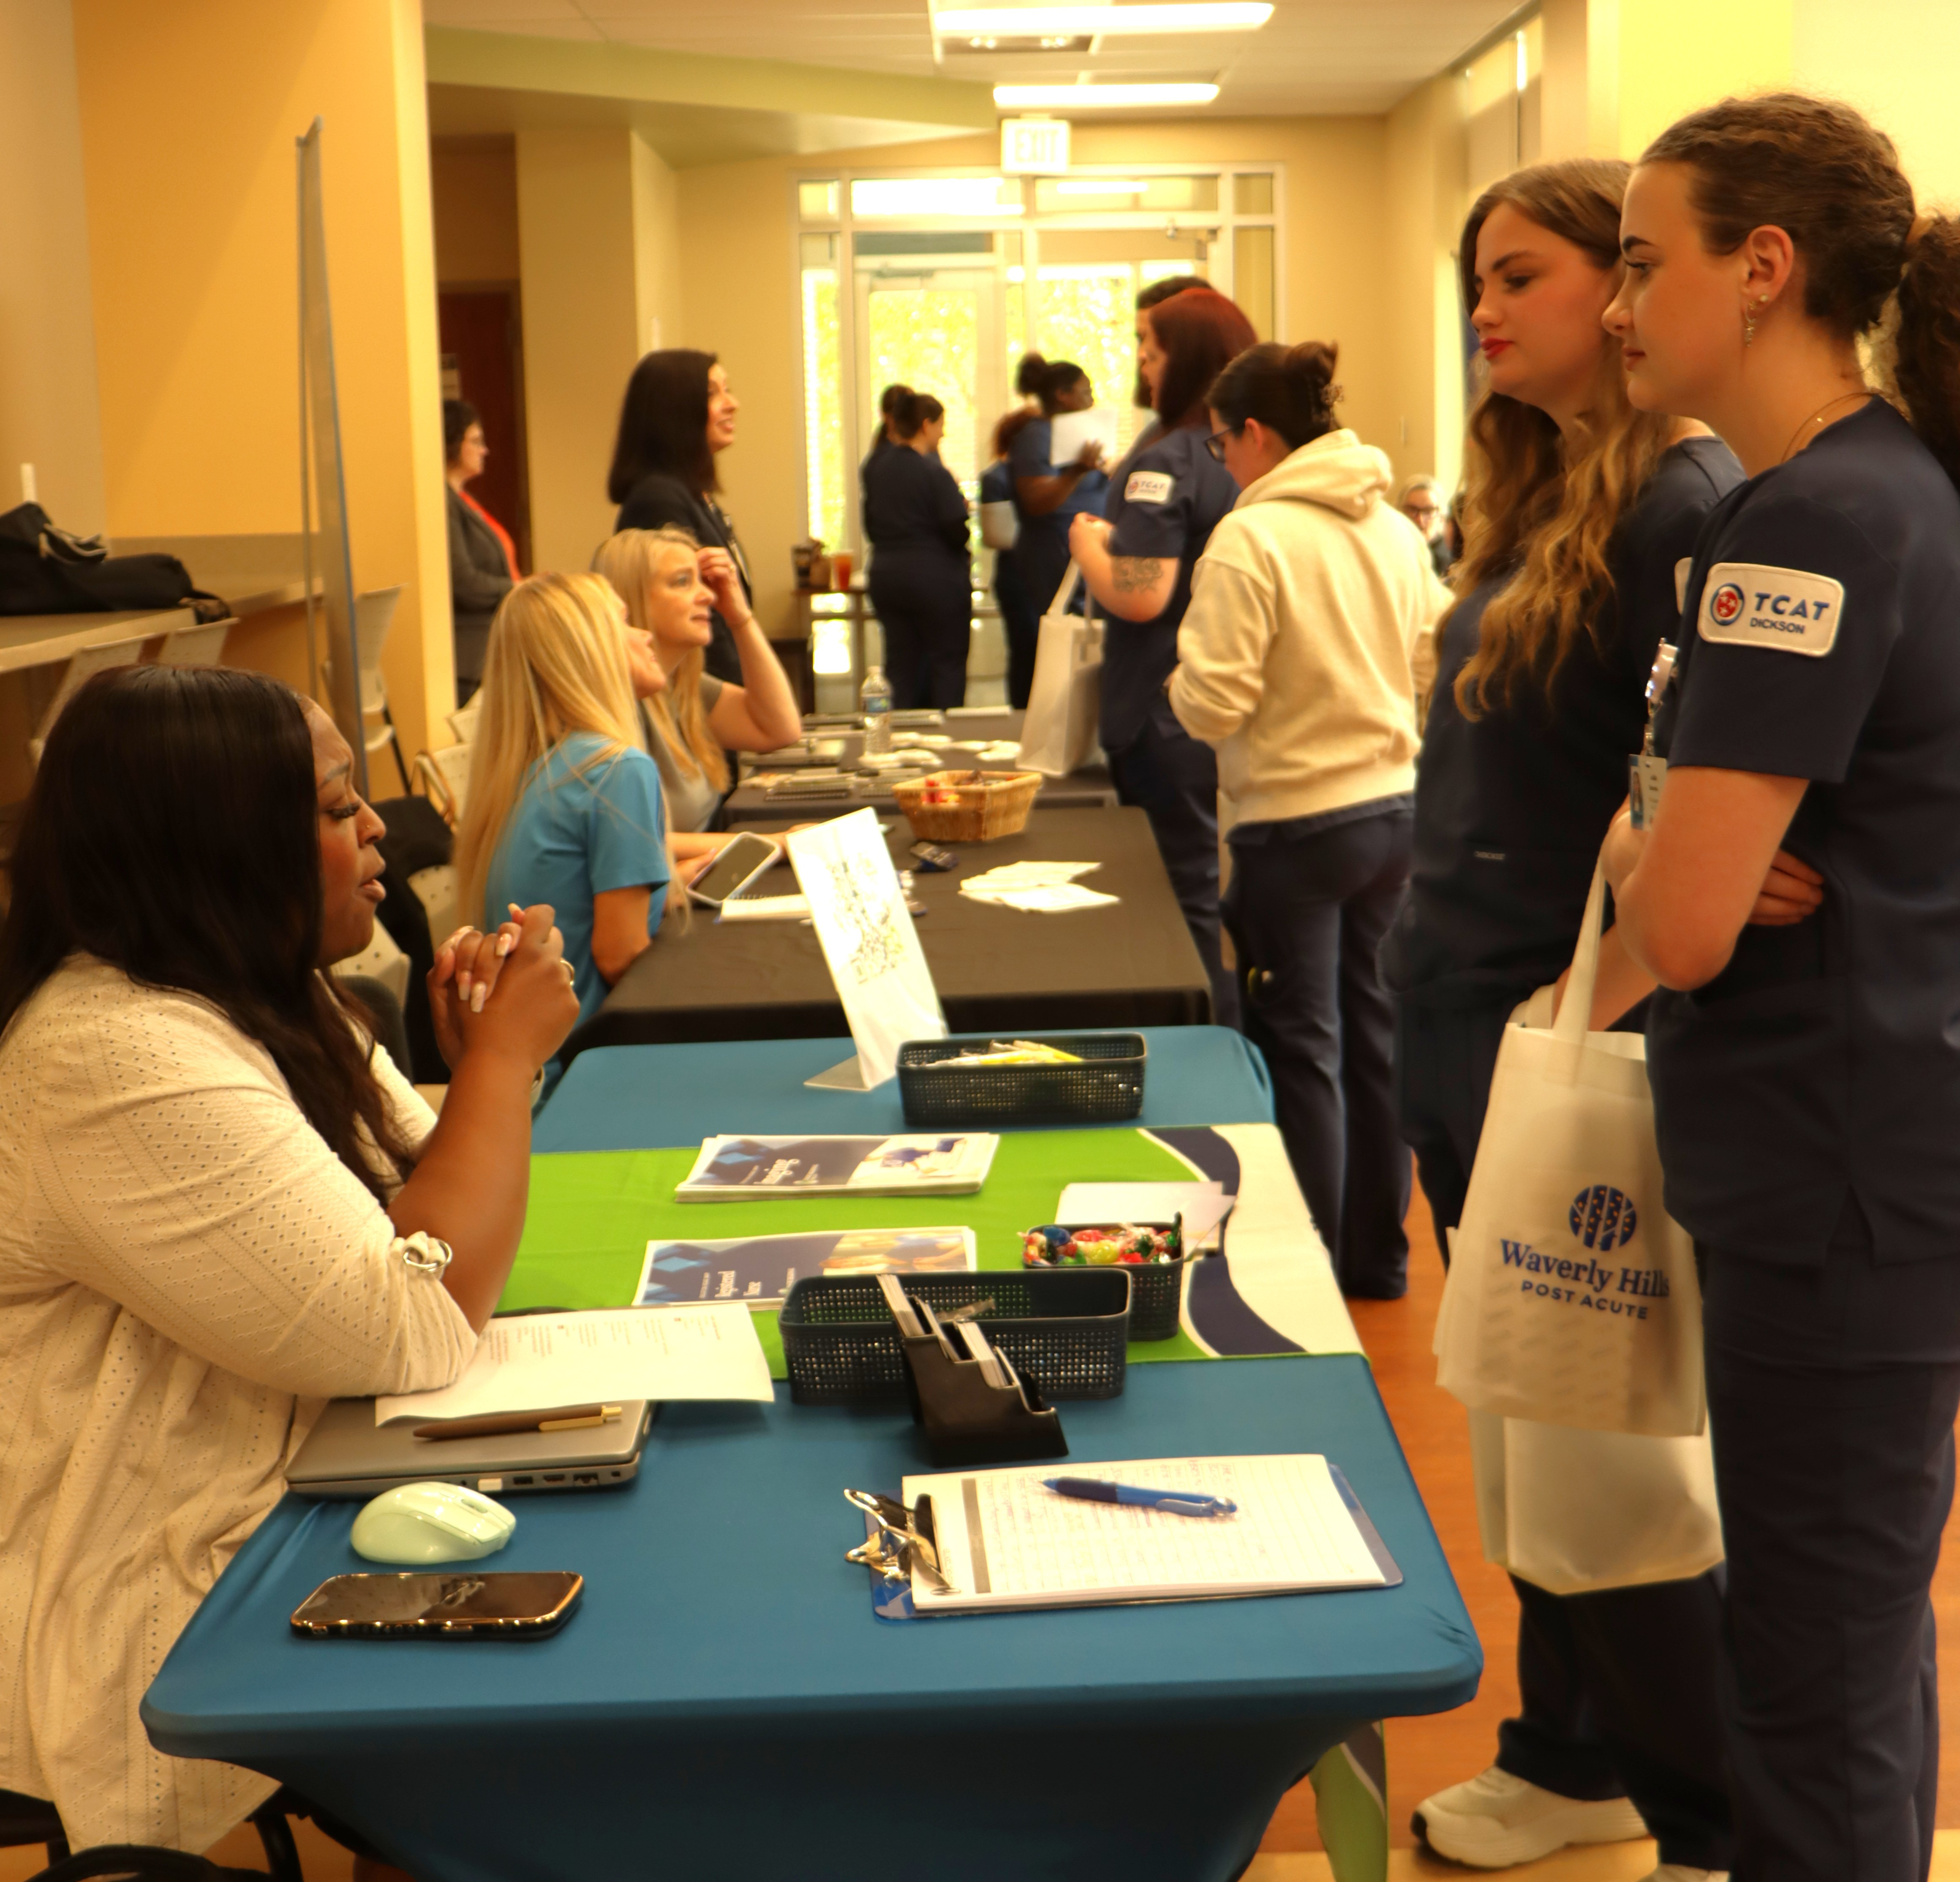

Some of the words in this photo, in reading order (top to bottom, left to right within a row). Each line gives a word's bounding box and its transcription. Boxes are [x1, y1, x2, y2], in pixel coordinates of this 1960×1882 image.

[1015, 128, 1059, 163] EXIT
[1141, 481, 1165, 490] TCAT
[1755, 592, 1829, 620] TCAT
[1750, 617, 1806, 634] DICKSON
[1500, 1238, 1613, 1293] Waverly
[1617, 1267, 1670, 1298] Hills
[1521, 1280, 1576, 1303] POST
[1580, 1294, 1649, 1320] ACUTE
